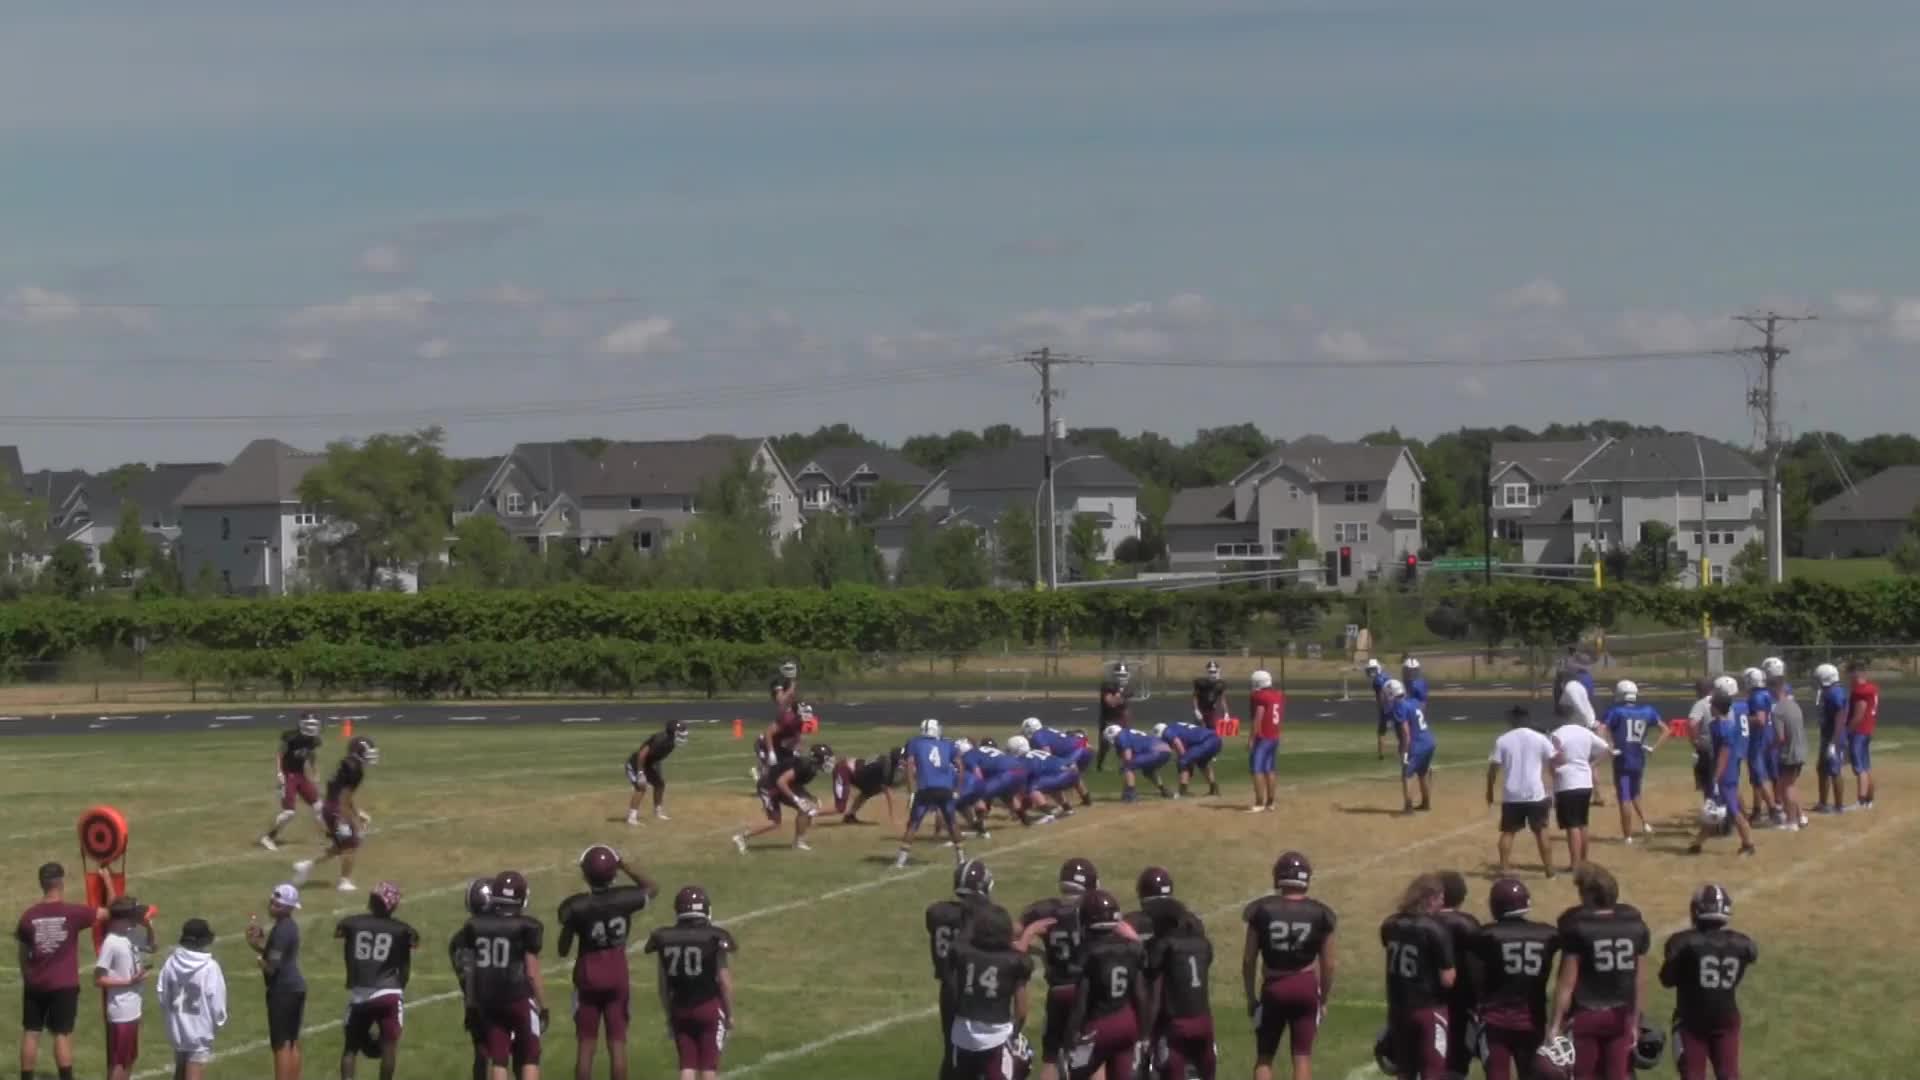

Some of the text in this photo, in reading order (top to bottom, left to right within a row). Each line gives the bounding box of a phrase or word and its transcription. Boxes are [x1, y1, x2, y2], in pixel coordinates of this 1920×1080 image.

[1272, 703, 1280, 725] 5
[1740, 714, 1750, 737] 9
[1625, 719, 1646, 742] 19
[928, 746, 941, 768] 4
[355, 930, 393, 961] 68
[1269, 920, 1312, 950] 27
[475, 936, 510, 968] 30
[663, 946, 703, 976] 70
[1502, 941, 1545, 976] 55
[1593, 938, 1635, 972] 52
[964, 962, 999, 998] 14
[1111, 965, 1129, 998] 6
[1188, 955, 1201, 988] 1
[1700, 955, 1740, 989] 63
